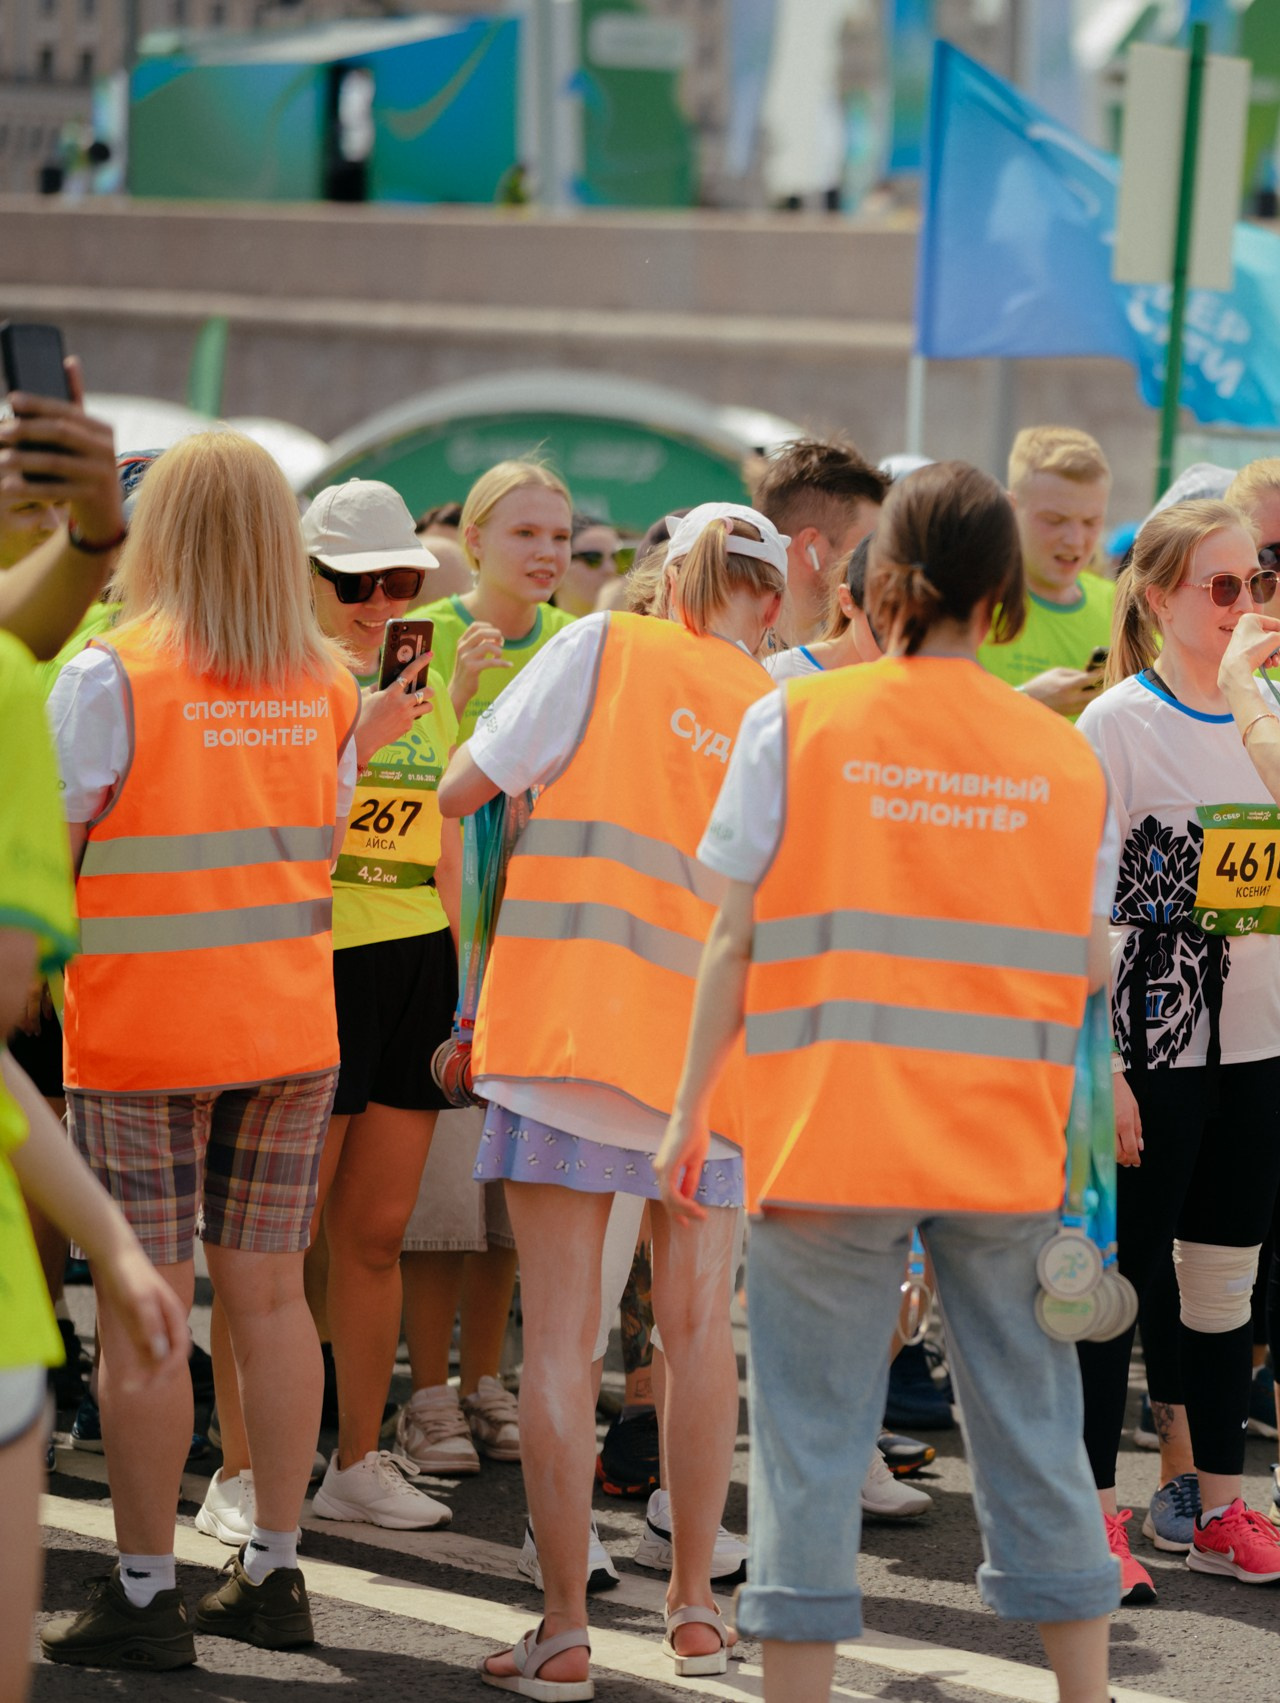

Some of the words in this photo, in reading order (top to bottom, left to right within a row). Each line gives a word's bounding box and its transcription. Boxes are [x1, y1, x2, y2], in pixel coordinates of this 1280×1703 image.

[1127, 300, 1244, 399] СТИ
[183, 697, 329, 720] СПОРТИВНЫЙ
[203, 725, 318, 747] ВОЛОНТЁР
[670, 708, 732, 764] Суд
[842, 760, 1050, 804] СПОРТИВНЫЙ
[350, 799, 423, 837] 267
[870, 795, 1028, 832] ВОЛОНТЁР
[1222, 813, 1241, 821] СБЕР
[366, 835, 396, 850] АЙСА
